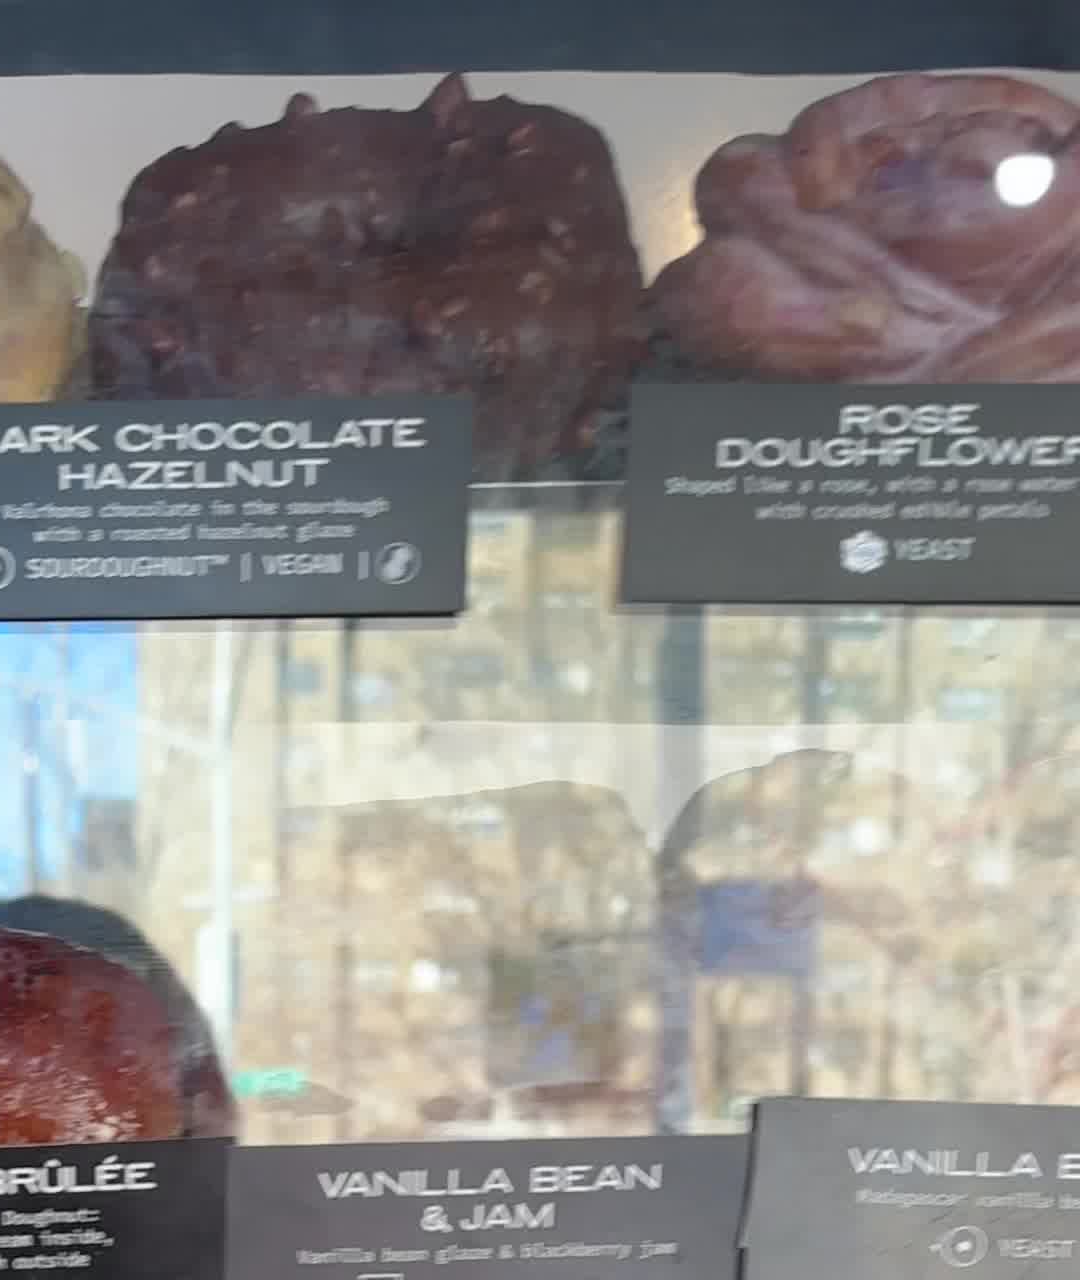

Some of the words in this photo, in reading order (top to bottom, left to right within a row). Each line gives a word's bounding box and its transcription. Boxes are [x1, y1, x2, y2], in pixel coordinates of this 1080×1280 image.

[839, 403, 981, 435] ROSE
[115, 418, 427, 452] CHOCOLATE
[57, 458, 330, 490] HAZELNUT
[262, 553, 343, 575] VEGAN
[894, 537, 976, 561] YEAST
[848, 1147, 1043, 1177] VANILLA
[316, 1167, 515, 1199] VANILLA
[528, 1163, 663, 1194] BEAN
[420, 1205, 453, 1233] &
[458, 1202, 556, 1231] JAM
[999, 1239, 1076, 1259] YEAST
